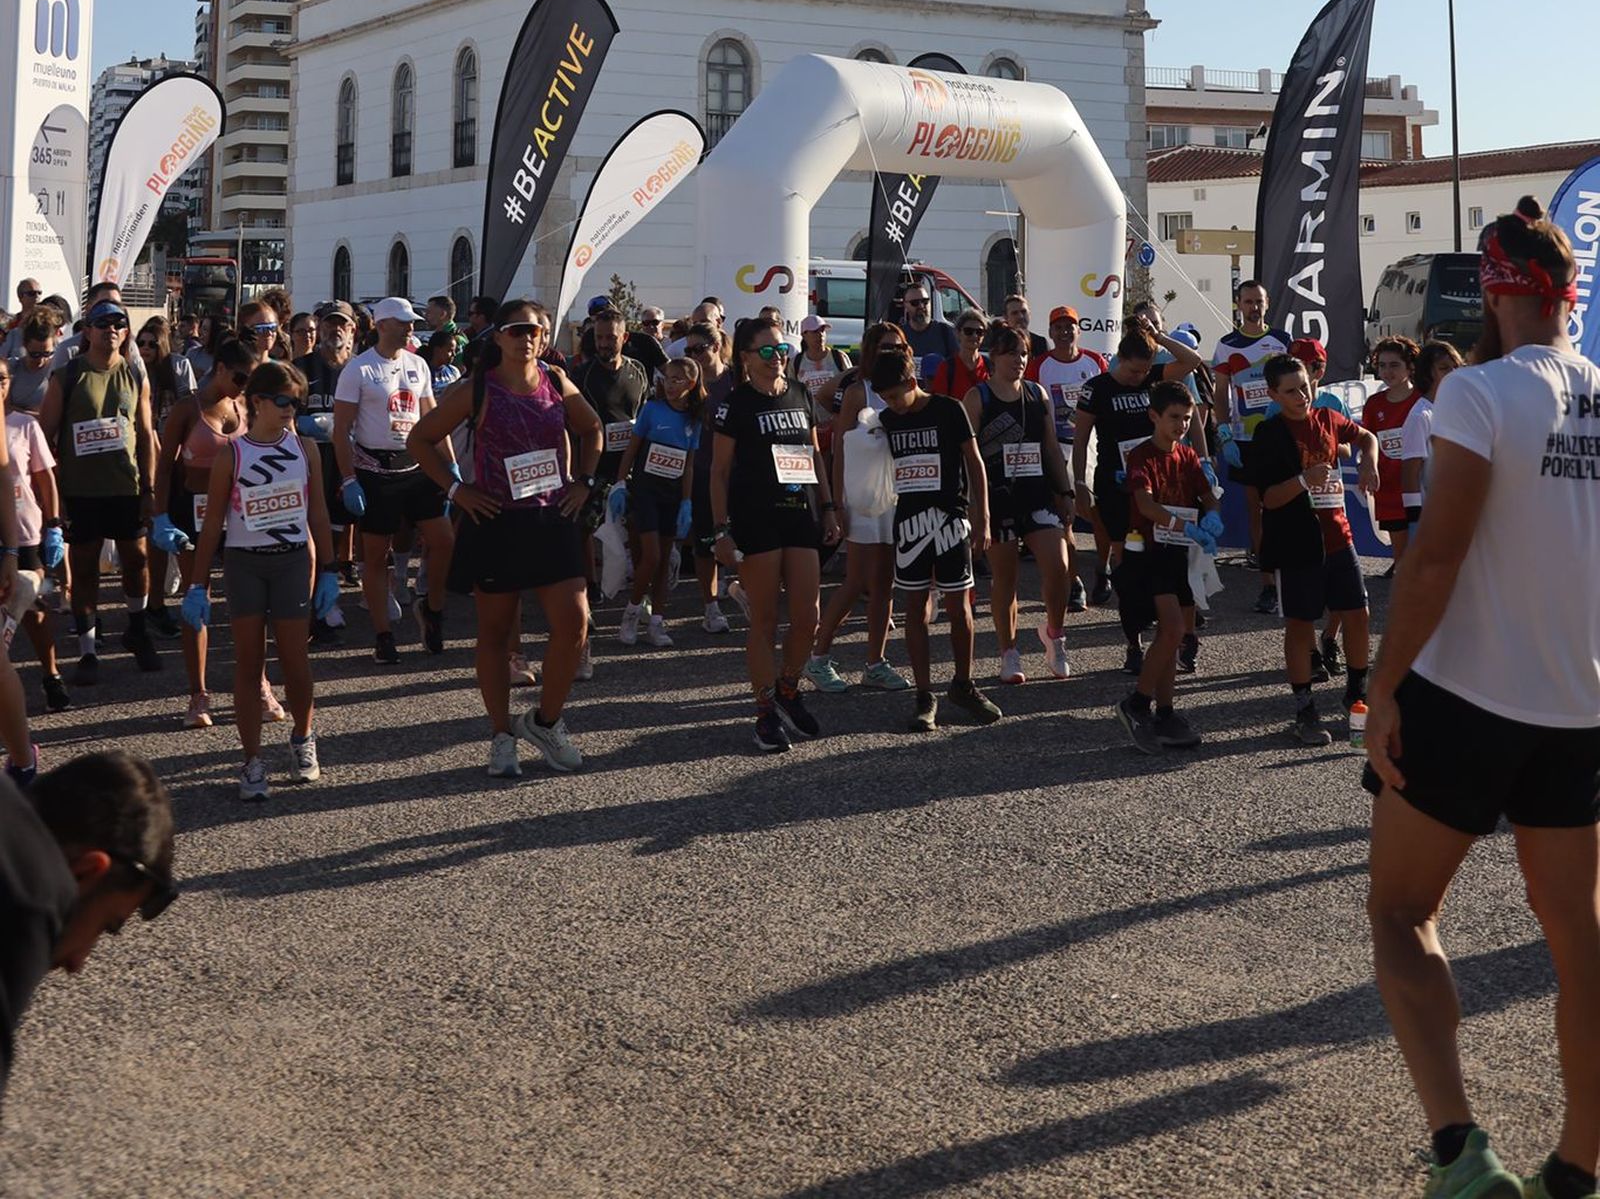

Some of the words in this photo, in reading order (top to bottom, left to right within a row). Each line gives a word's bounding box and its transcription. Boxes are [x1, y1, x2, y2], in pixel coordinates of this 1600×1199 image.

[33, 62, 77, 80] muelleuno
[503, 22, 594, 225] #BEACTIVE
[907, 121, 1021, 163] PLOGGING
[32, 146, 52, 165] 365
[53, 158, 68, 167] OPEN
[146, 110, 216, 196] PLOGGING
[632, 143, 697, 208] PLOGGING
[1285, 70, 1346, 349] GARMIN
[26, 221, 48, 231] TIENDAS
[590, 213, 617, 243] nationale
[1112, 392, 1151, 411] FITCLU
[758, 411, 808, 435] FITCLUB
[891, 429, 938, 452] FITCLUB
[514, 462, 555, 482] 25069
[778, 458, 810, 470] 25779
[897, 466, 936, 480] 25780
[249, 494, 299, 514] 25068
